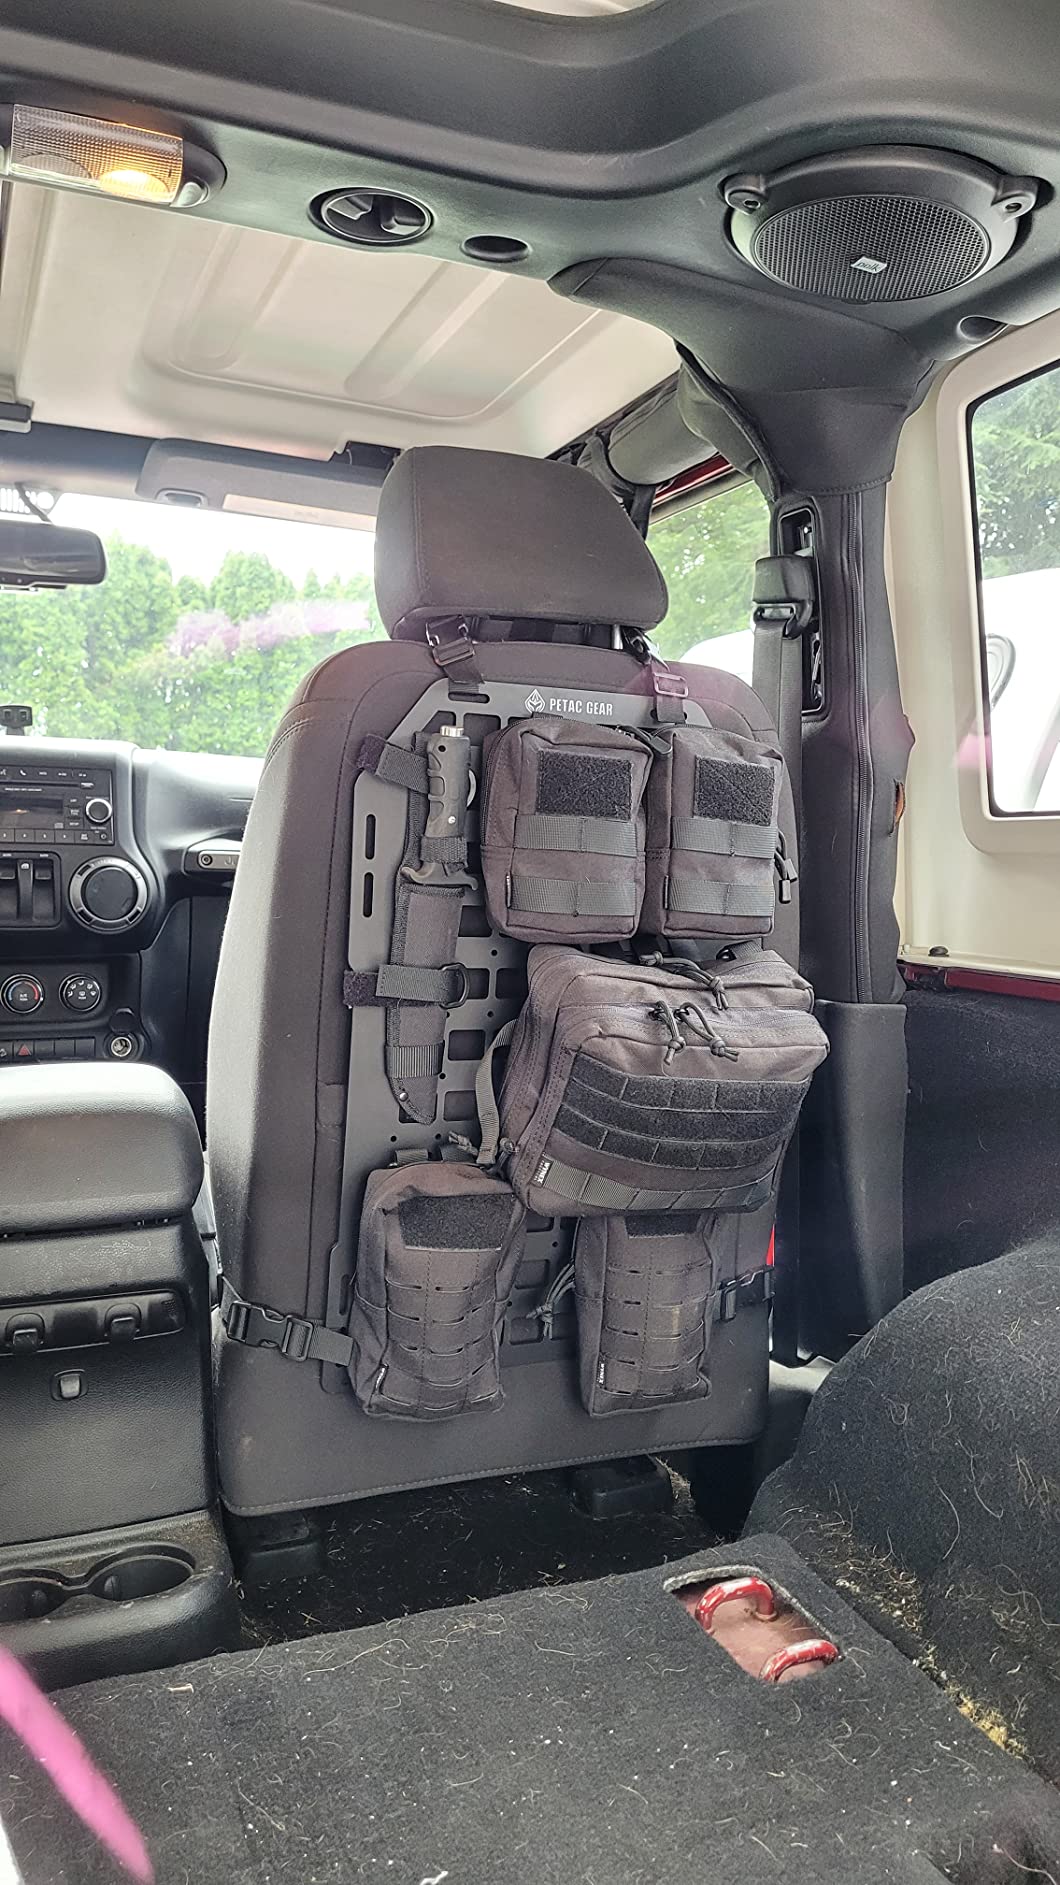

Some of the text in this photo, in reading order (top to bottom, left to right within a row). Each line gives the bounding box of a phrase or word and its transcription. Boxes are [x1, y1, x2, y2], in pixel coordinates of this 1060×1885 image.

[857, 262, 879, 272] polk
[549, 698, 613, 716] PETAC GEAR
